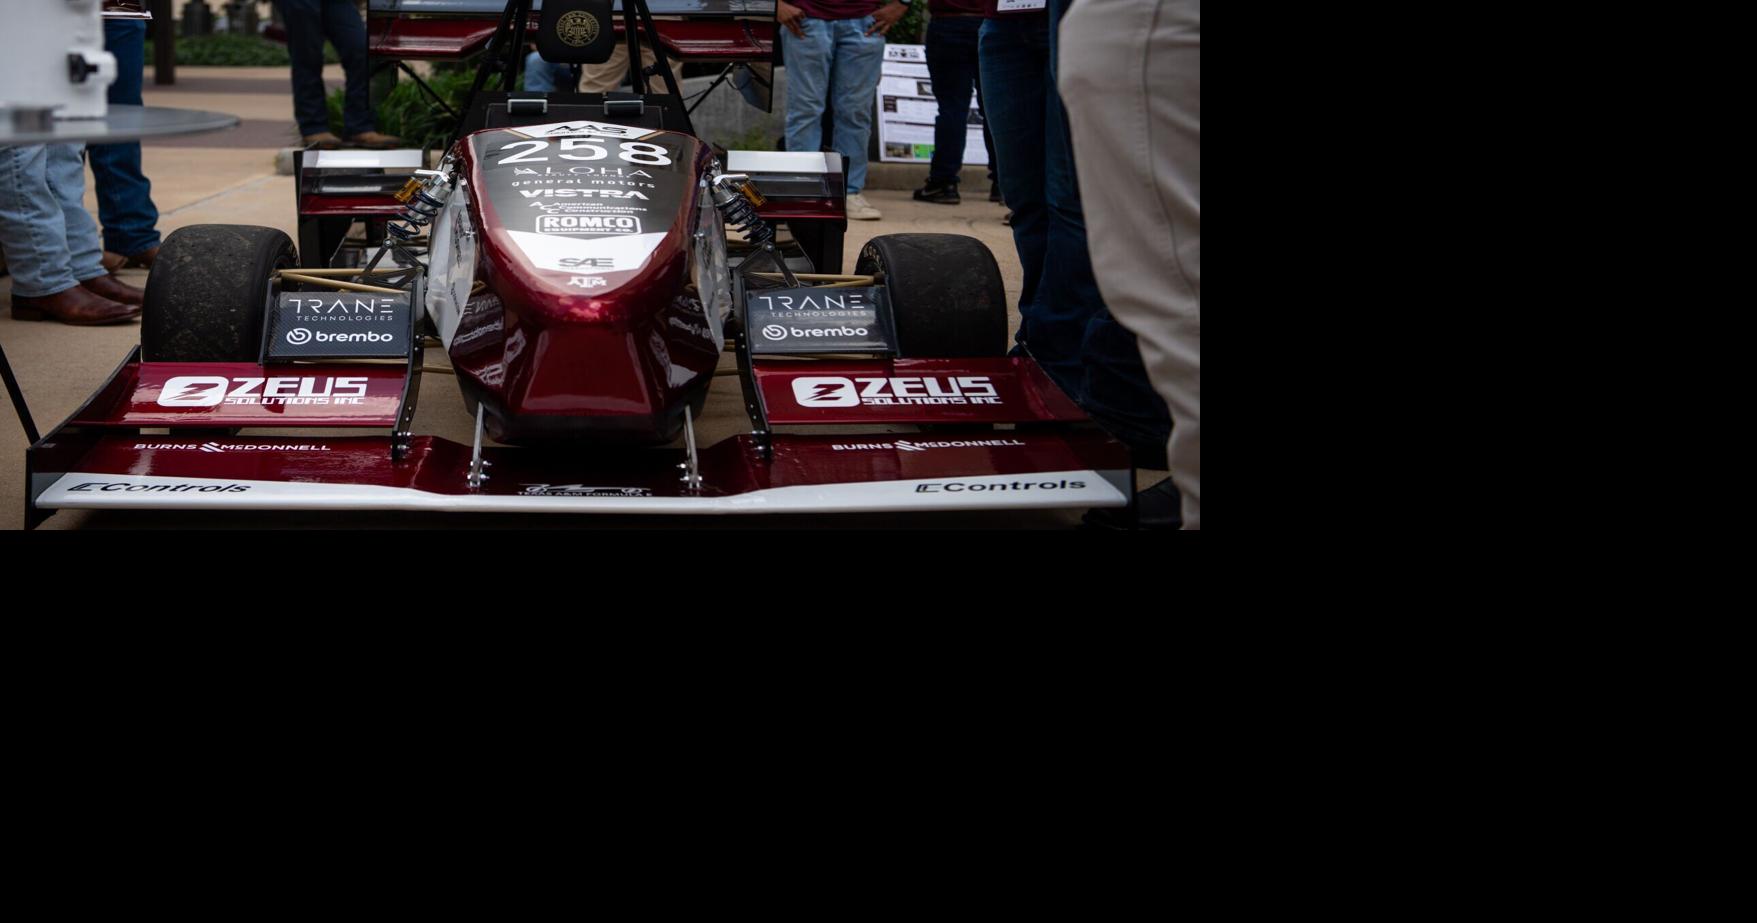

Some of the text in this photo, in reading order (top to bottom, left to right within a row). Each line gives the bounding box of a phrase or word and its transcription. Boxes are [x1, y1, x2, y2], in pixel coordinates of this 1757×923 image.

[498, 138, 672, 166] 258
[514, 166, 652, 179] ALOHA
[512, 179, 655, 189] general motors
[520, 188, 650, 200] VISTRA
[544, 216, 634, 228] ROMCO
[559, 257, 614, 267] SAE
[289, 299, 394, 313] TRANE
[759, 295, 865, 310] TRANE
[772, 310, 867, 318] TECHNOLOGIES
[315, 331, 393, 342] brembo
[790, 326, 868, 338] brembo
[227, 377, 368, 397] ZEUS
[855, 376, 998, 397] ZEUS
[224, 396, 365, 405] SOLUTIONS INC
[860, 396, 1003, 405] SOLUTIONS INC
[832, 443, 894, 451] BURNS
